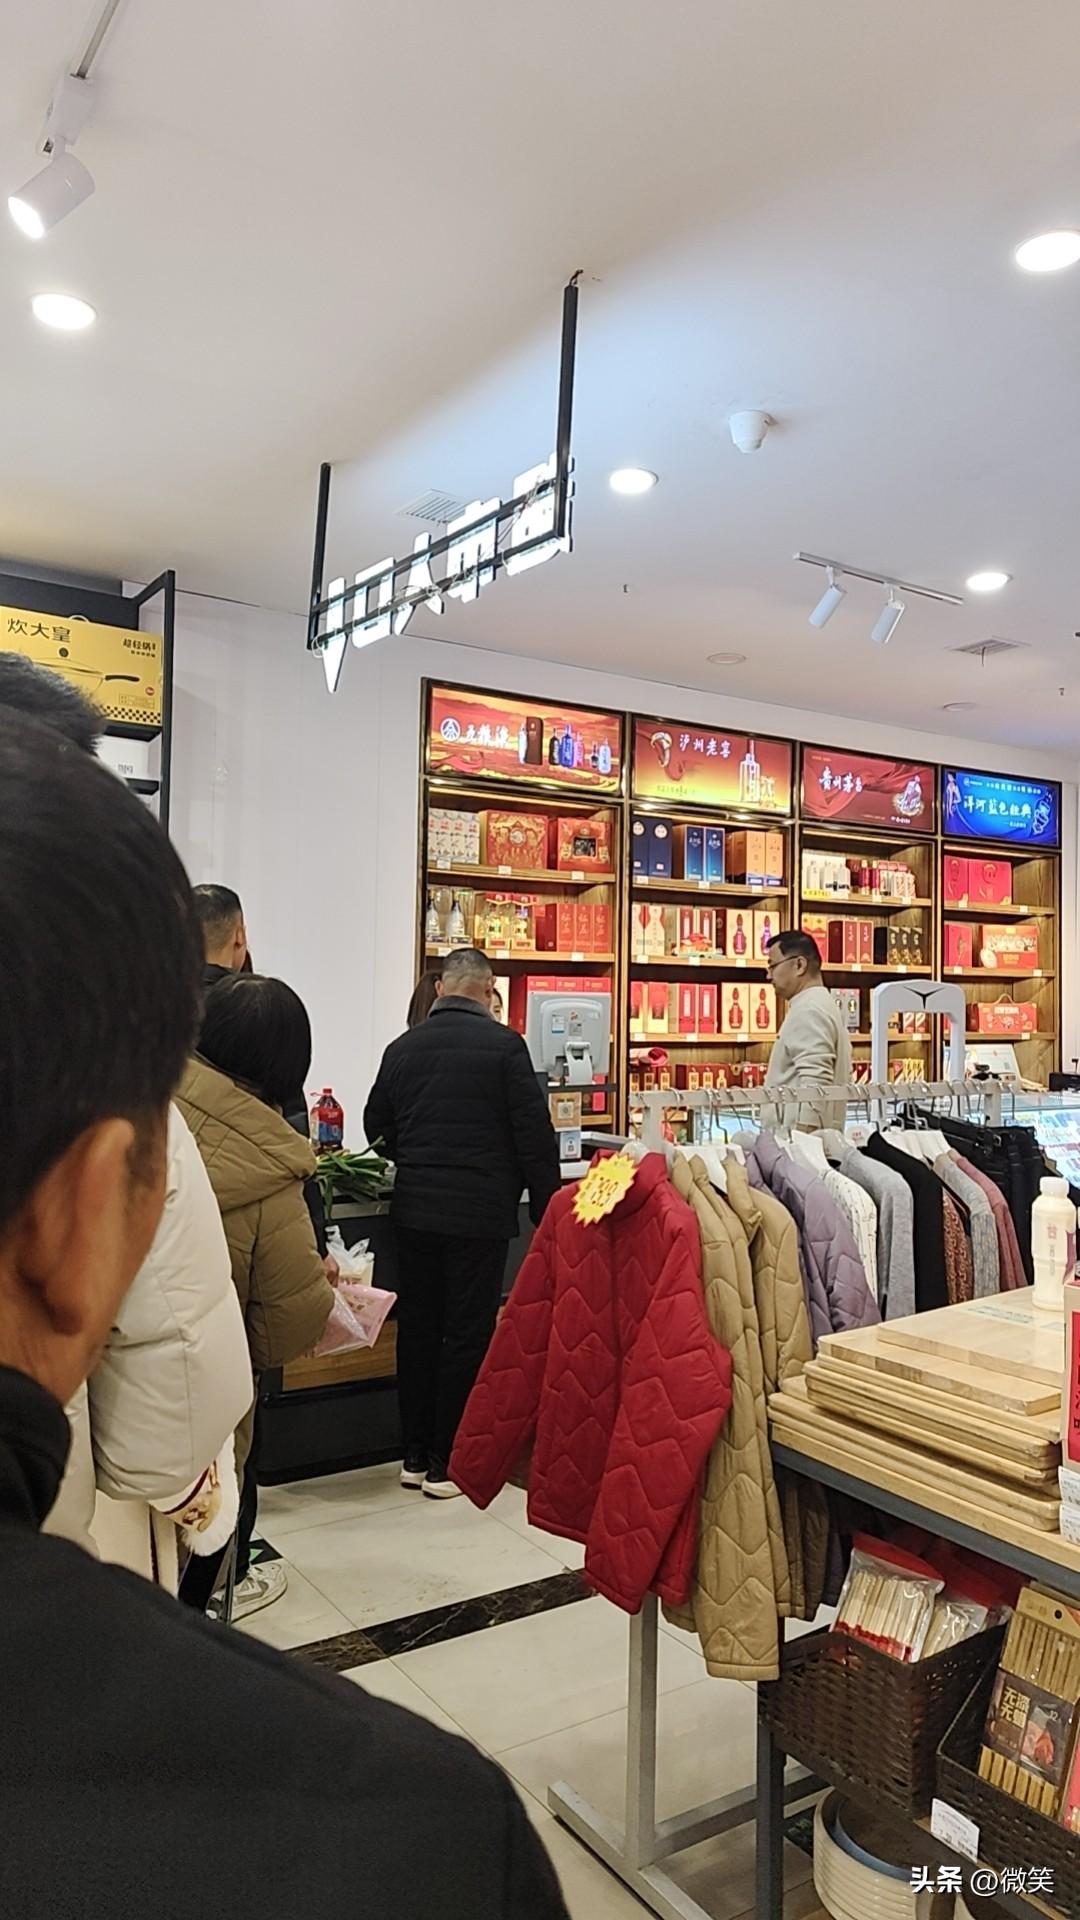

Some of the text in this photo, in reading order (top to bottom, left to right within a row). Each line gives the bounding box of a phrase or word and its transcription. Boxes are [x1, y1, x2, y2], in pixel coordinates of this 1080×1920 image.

[7, 617, 71, 643] 炊大皇
[679, 733, 731, 759] 泸州老窖
